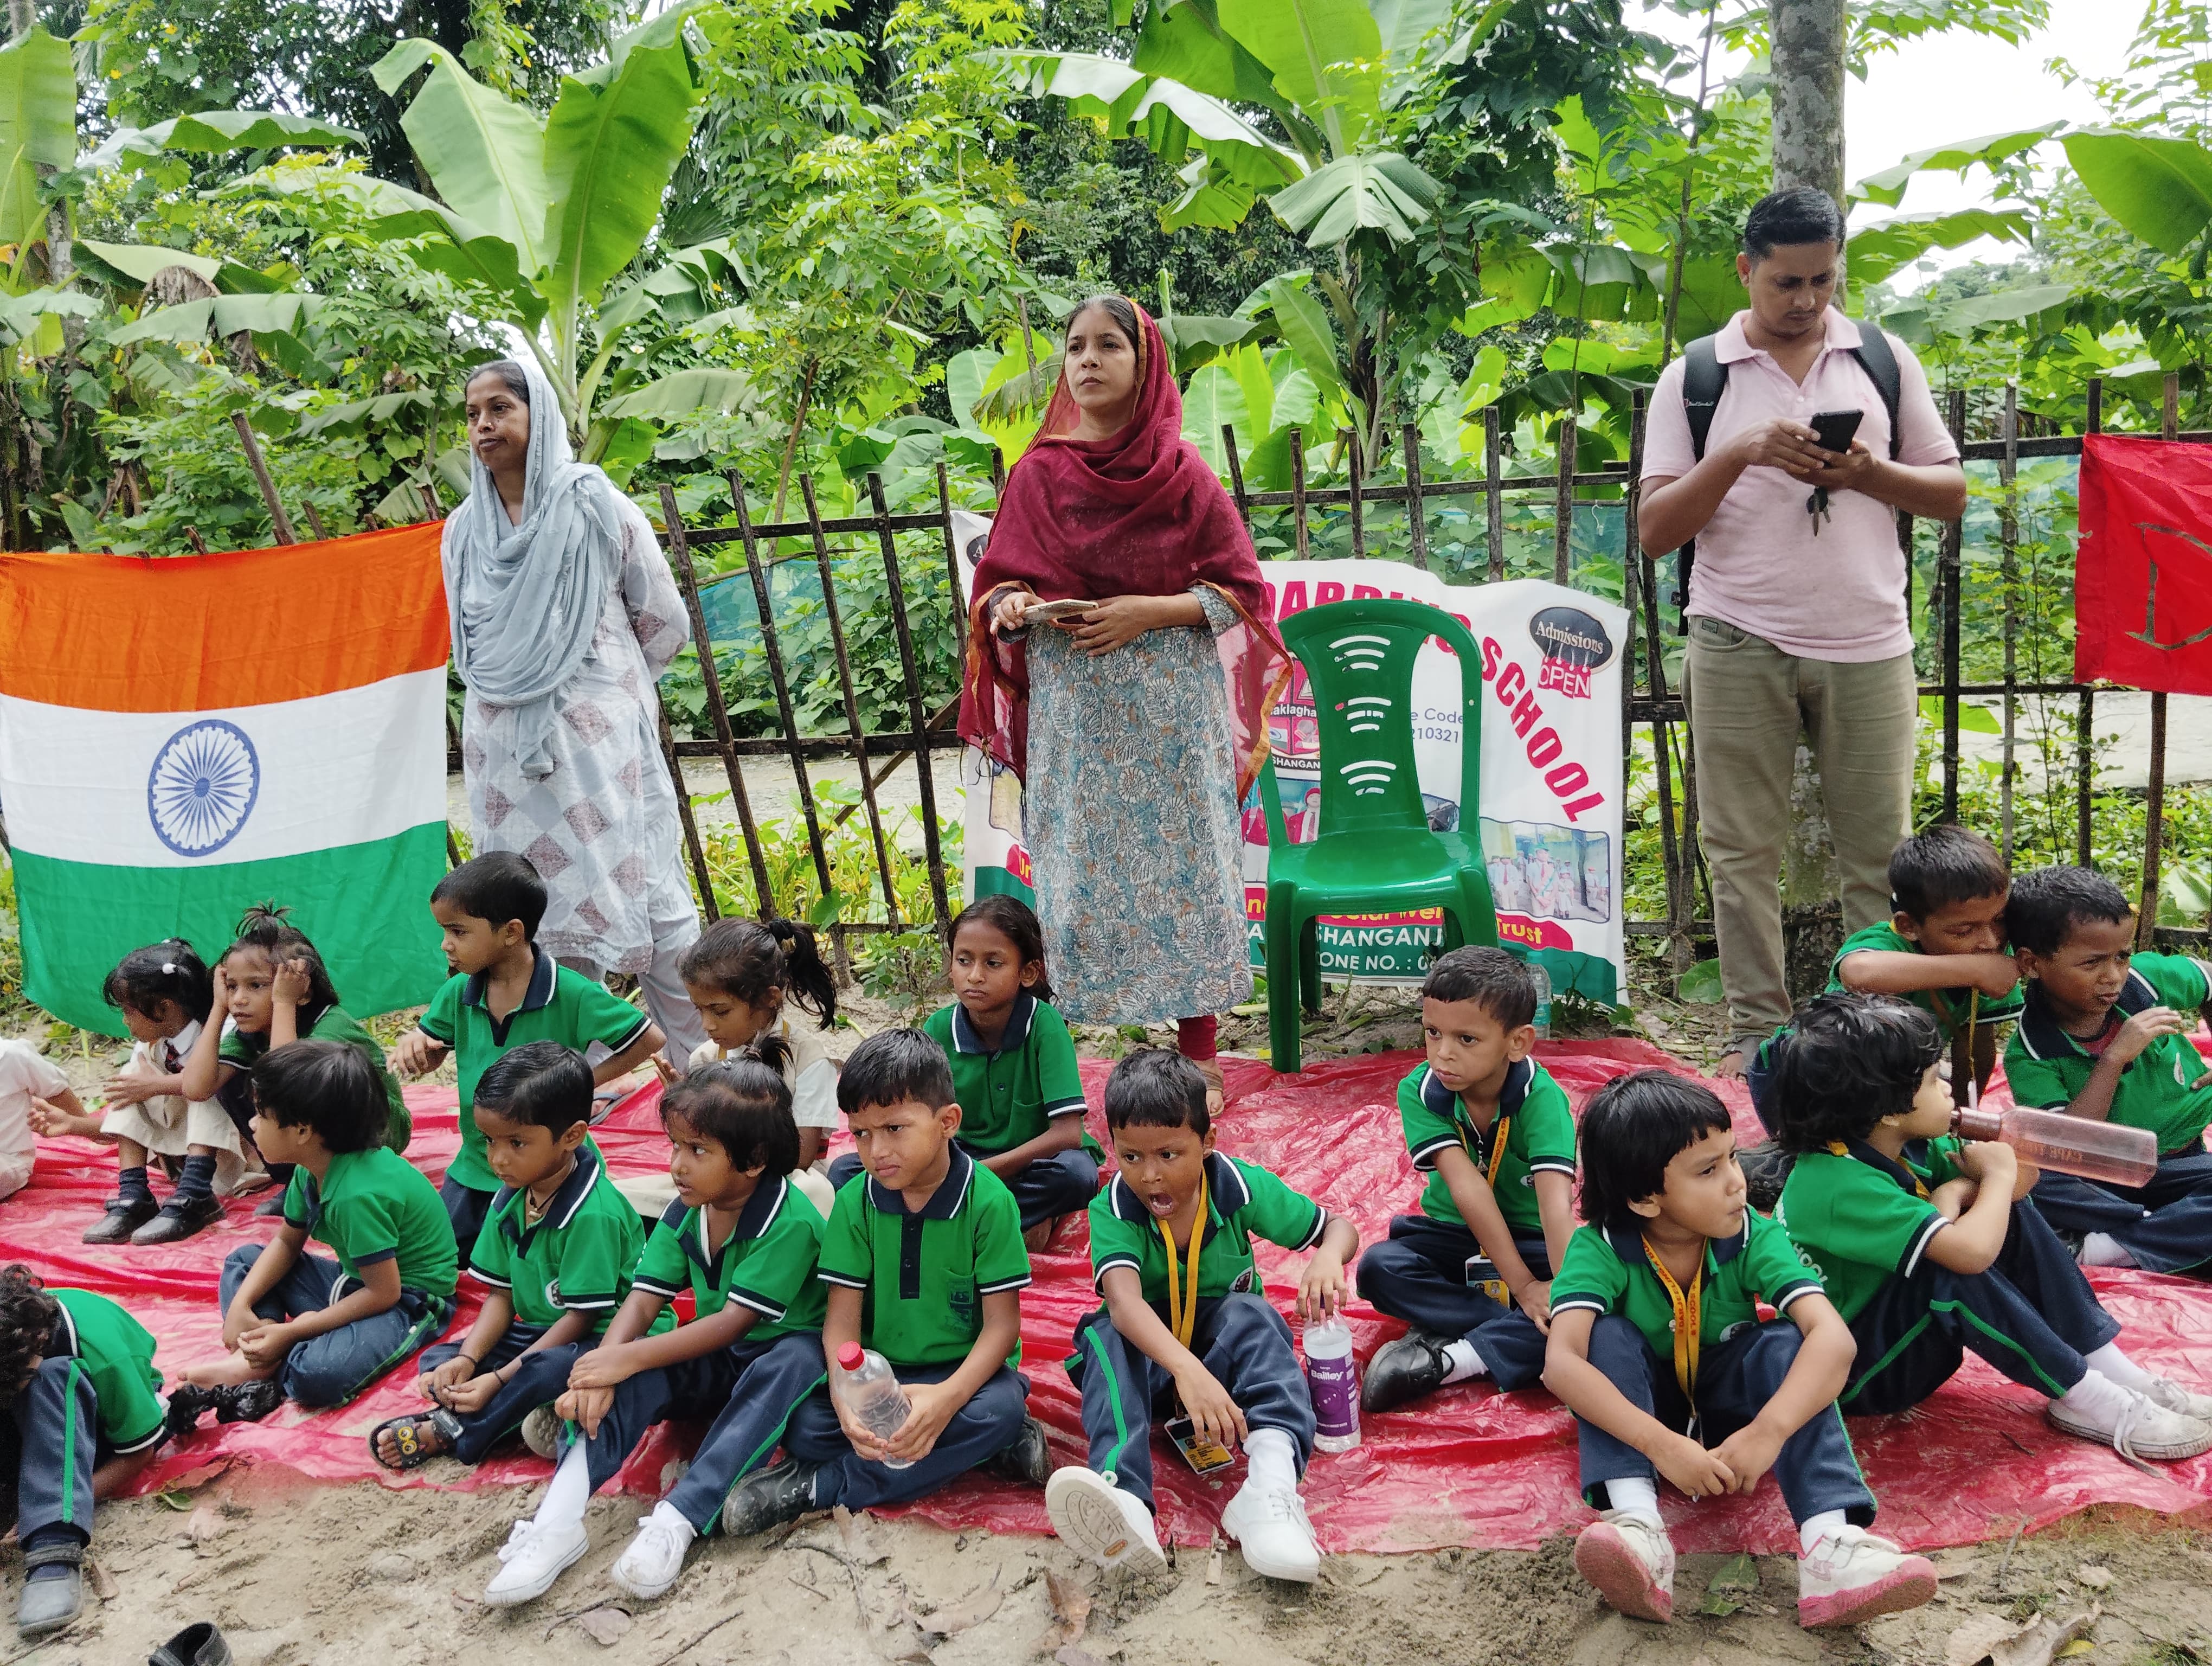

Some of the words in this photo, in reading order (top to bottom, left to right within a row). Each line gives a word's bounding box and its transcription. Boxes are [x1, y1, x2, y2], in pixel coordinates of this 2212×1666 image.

[1535, 620, 1604, 655] Admissions
[1538, 664, 1590, 696] OPEN
[1424, 708, 1463, 724] Code
[1481, 636, 1605, 822] SCHOOL
[1496, 918, 1542, 945] Trust
[1319, 951, 1360, 970] ONE
[1365, 954, 1400, 971] NO.
